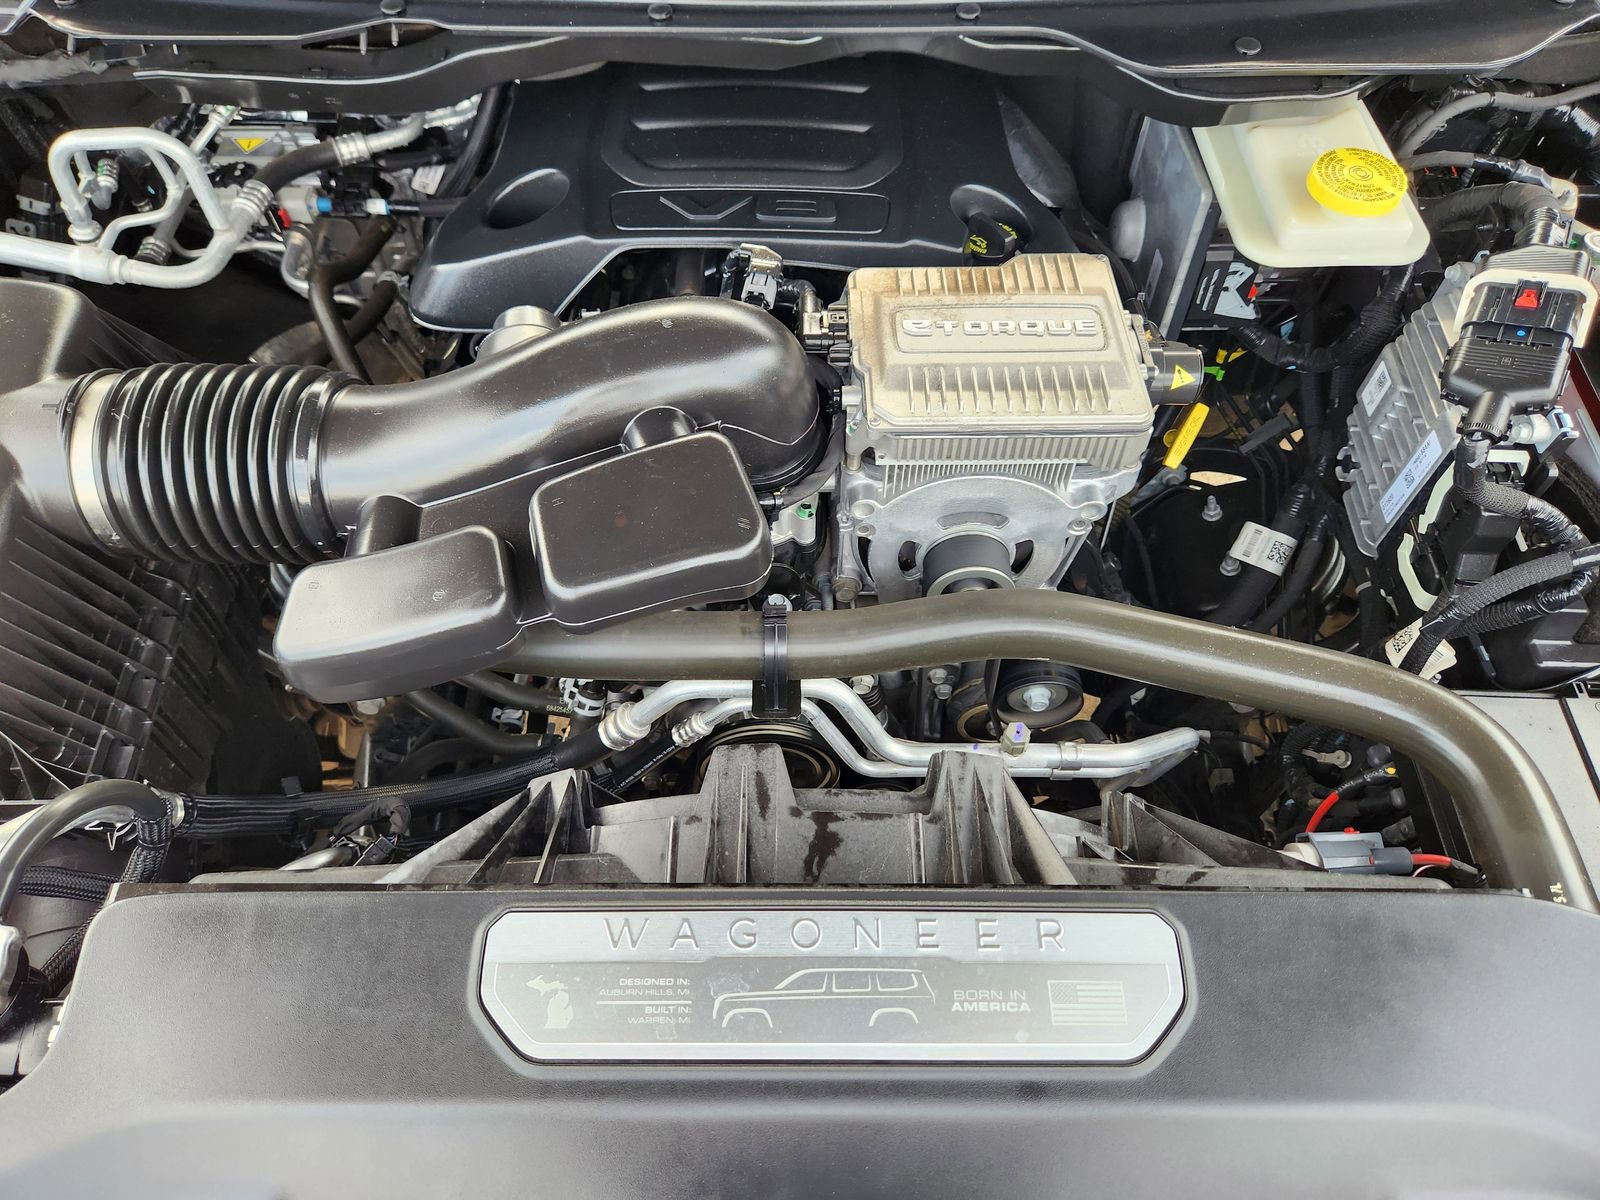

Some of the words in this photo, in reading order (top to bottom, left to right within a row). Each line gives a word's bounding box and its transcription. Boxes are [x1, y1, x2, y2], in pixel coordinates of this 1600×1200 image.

[603, 917, 1066, 952] WAGONEER
[619, 977, 674, 986] DESIGNED
[676, 977, 691, 986] IN:
[599, 987, 643, 996] AUBURN
[953, 990, 1002, 1001] BORN
[1009, 989, 1026, 1000] IN
[644, 1006, 676, 1014] BUILT
[678, 1006, 692, 1014] IN:
[951, 1002, 1031, 1013] AMERICA
